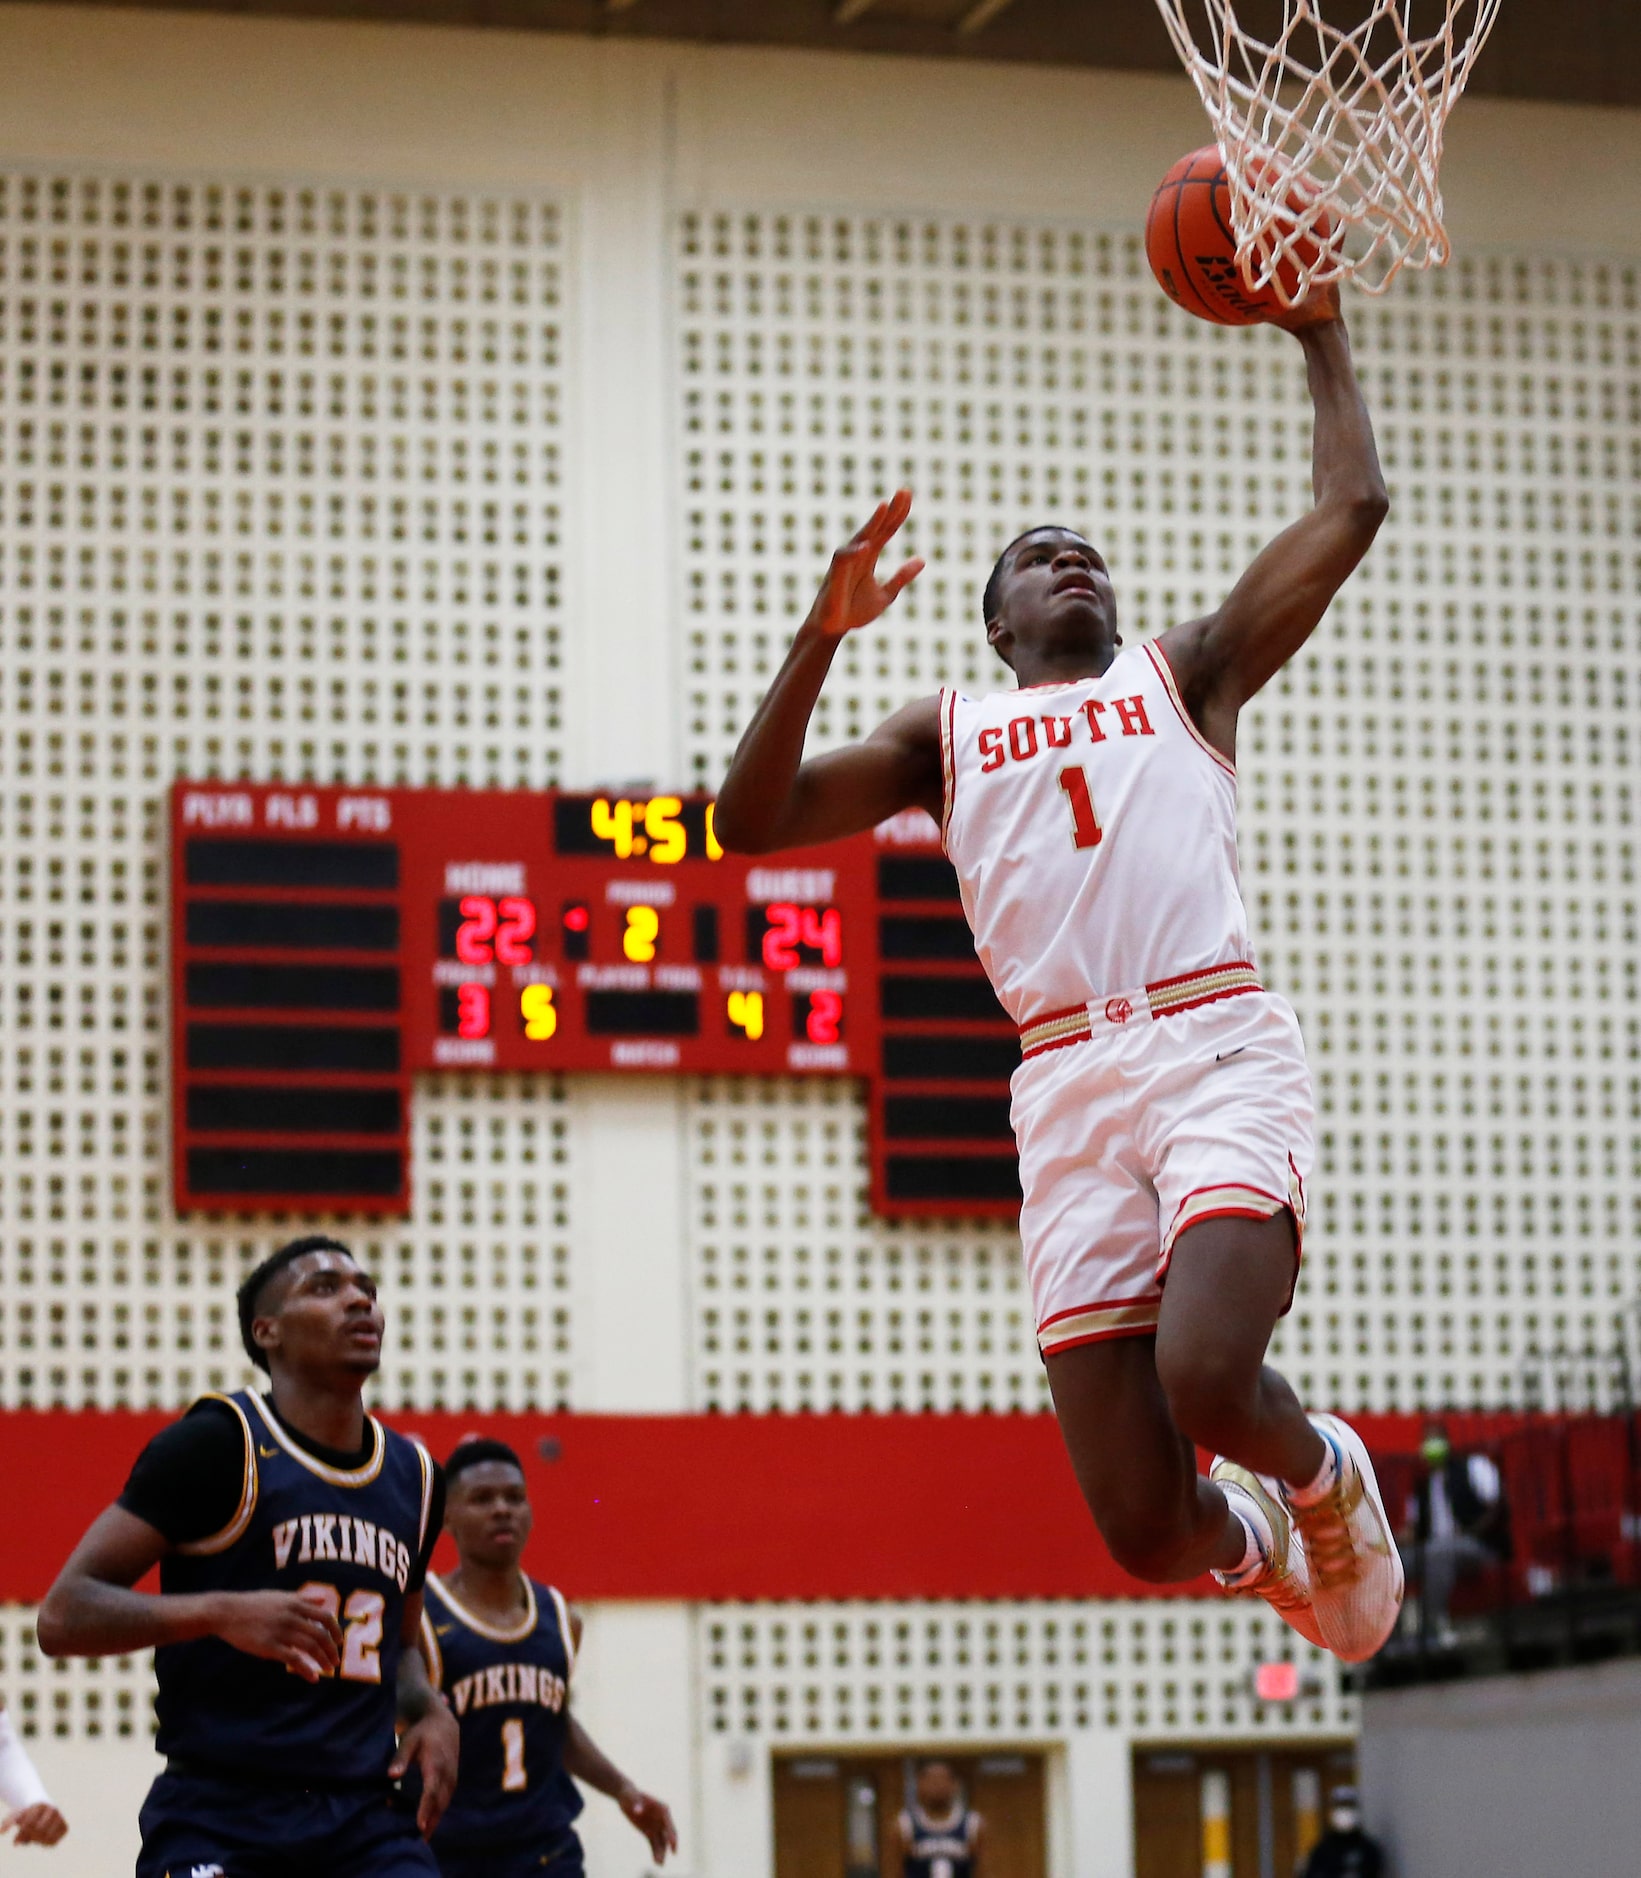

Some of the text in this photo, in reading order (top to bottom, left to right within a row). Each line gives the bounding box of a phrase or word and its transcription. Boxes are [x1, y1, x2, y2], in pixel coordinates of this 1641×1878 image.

[978, 695, 1155, 774] SOUTH
[1058, 765, 1102, 850] 1
[445, 862, 526, 895] HOME
[747, 868, 835, 902] GUEST
[456, 896, 536, 966] 22
[623, 905, 659, 962] 2
[763, 903, 842, 970] 24
[458, 982, 490, 1039] 3
[521, 984, 556, 1040] 5
[727, 991, 763, 1040] 4
[807, 989, 842, 1045] 2
[272, 1514, 410, 1594] VIKINGS
[452, 1663, 565, 1716] VIKINGS
[502, 1719, 527, 1792] 1
